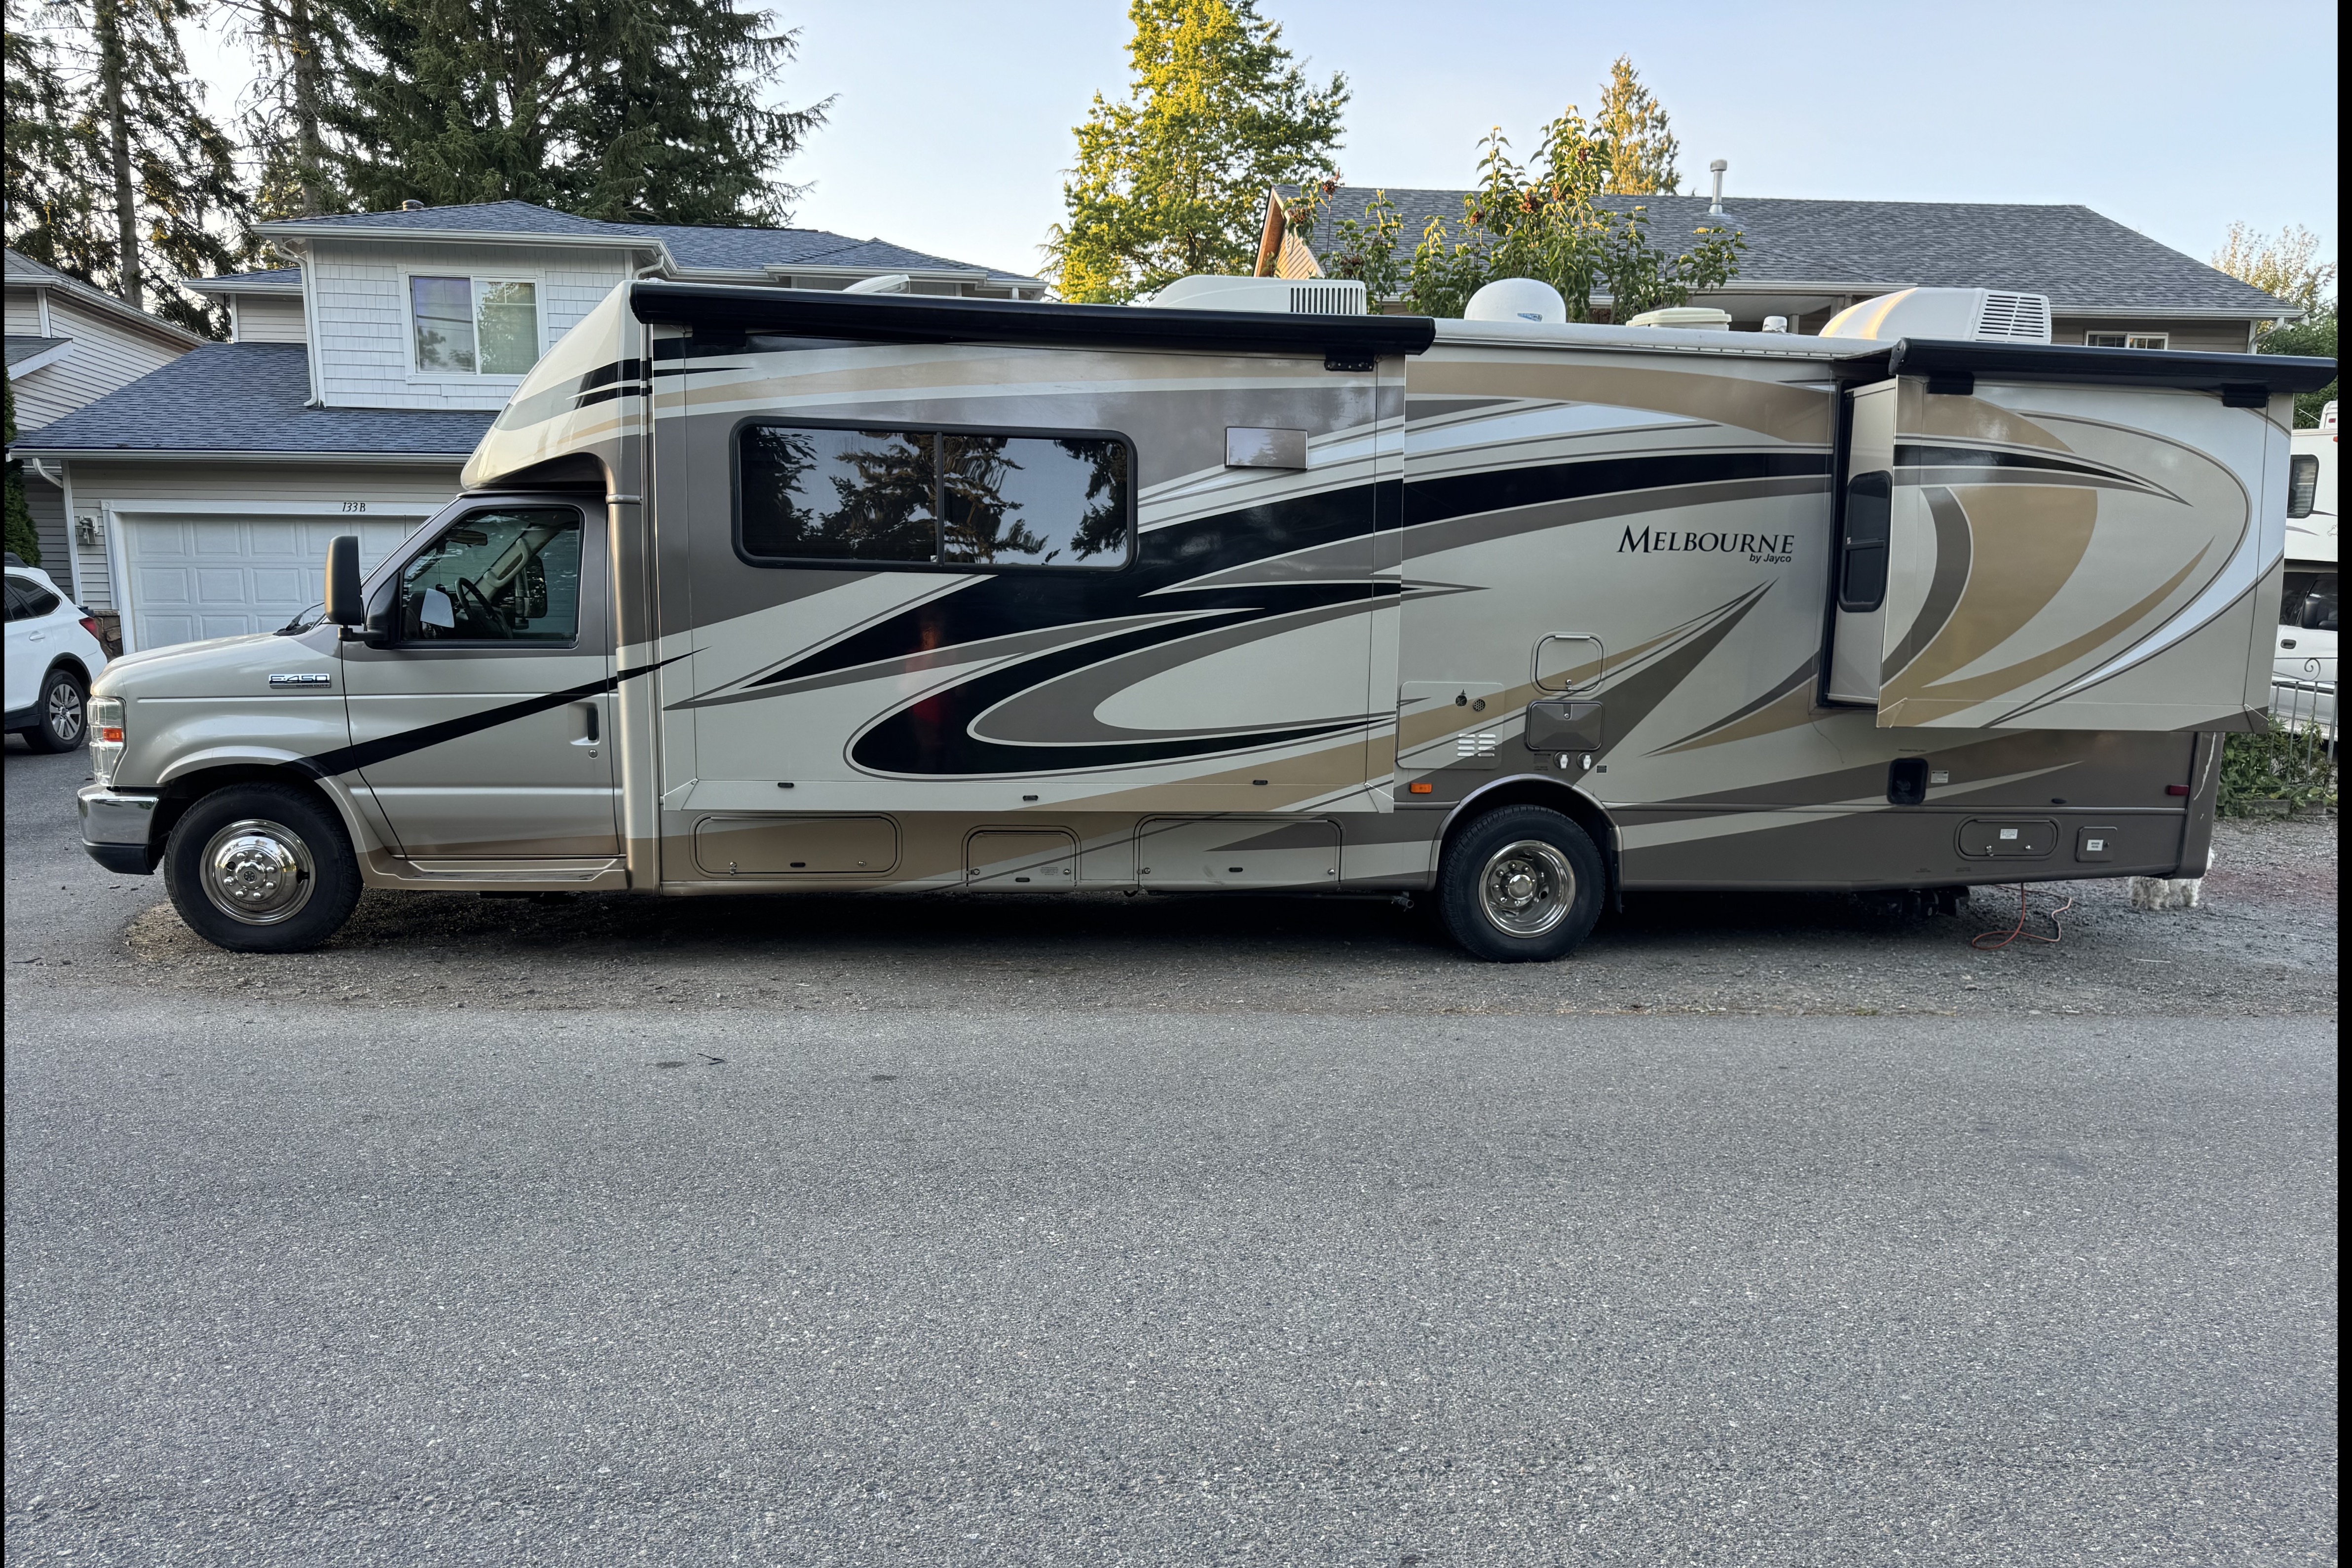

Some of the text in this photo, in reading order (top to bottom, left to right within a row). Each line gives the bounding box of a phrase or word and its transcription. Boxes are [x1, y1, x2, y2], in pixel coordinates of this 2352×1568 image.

[1616, 525, 1794, 554] MELBOURNE
[1750, 553, 1791, 564] by Jayco
